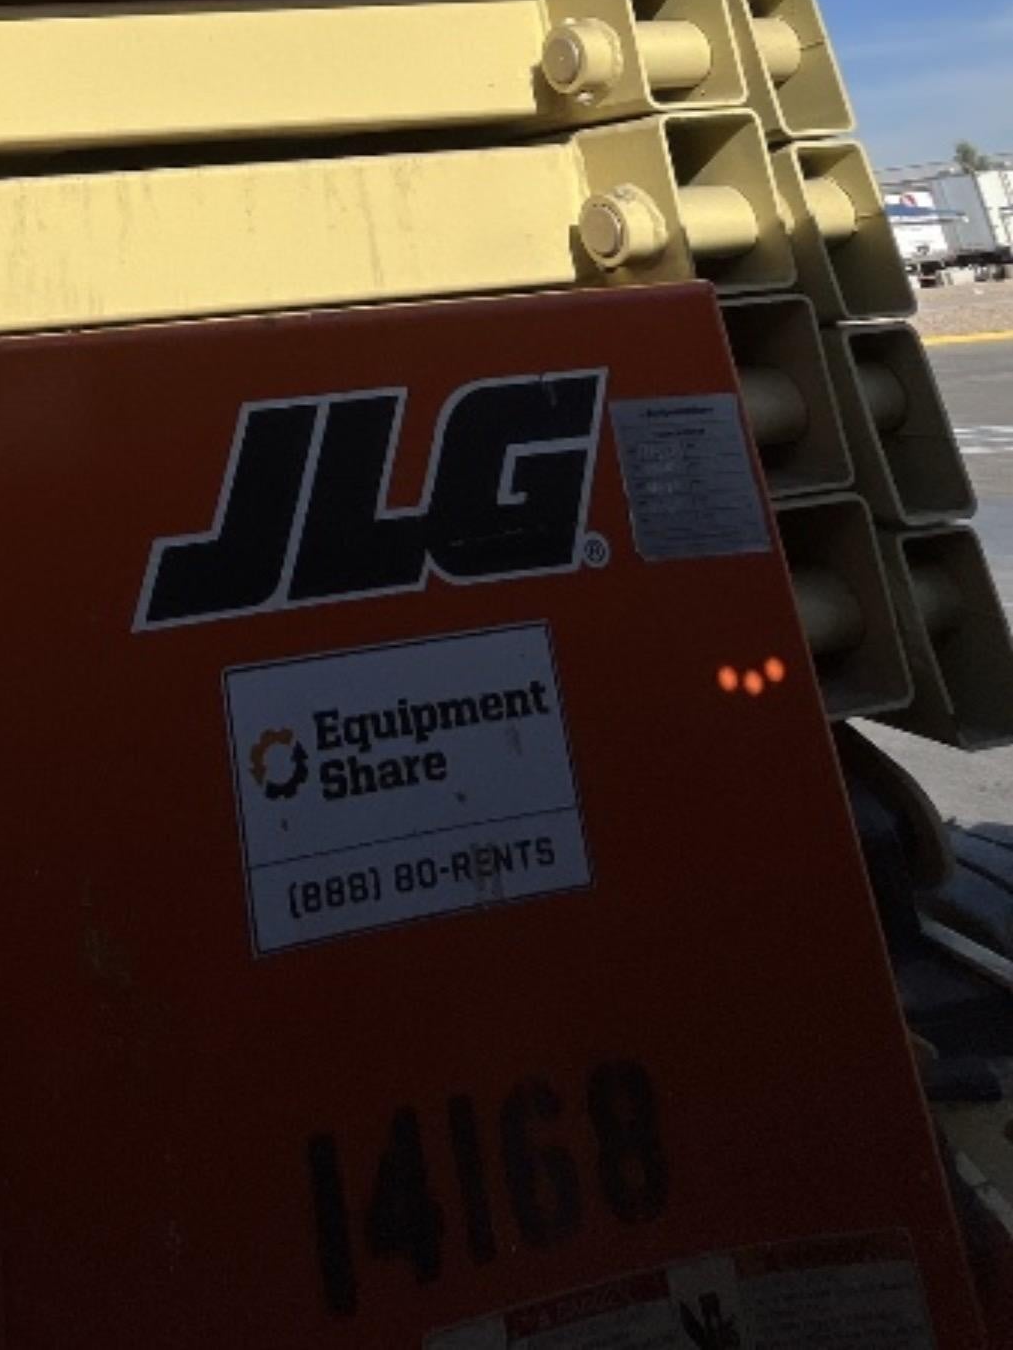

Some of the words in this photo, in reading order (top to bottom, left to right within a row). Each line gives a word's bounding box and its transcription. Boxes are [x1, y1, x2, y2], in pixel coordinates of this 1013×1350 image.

[131, 366, 610, 633] JLG
[312, 680, 549, 753] Equipment
[319, 749, 448, 801] Share
[288, 866, 382, 919] (888)
[394, 836, 556, 893] 80-RENTS
[305, 1058, 671, 1318] 14168
